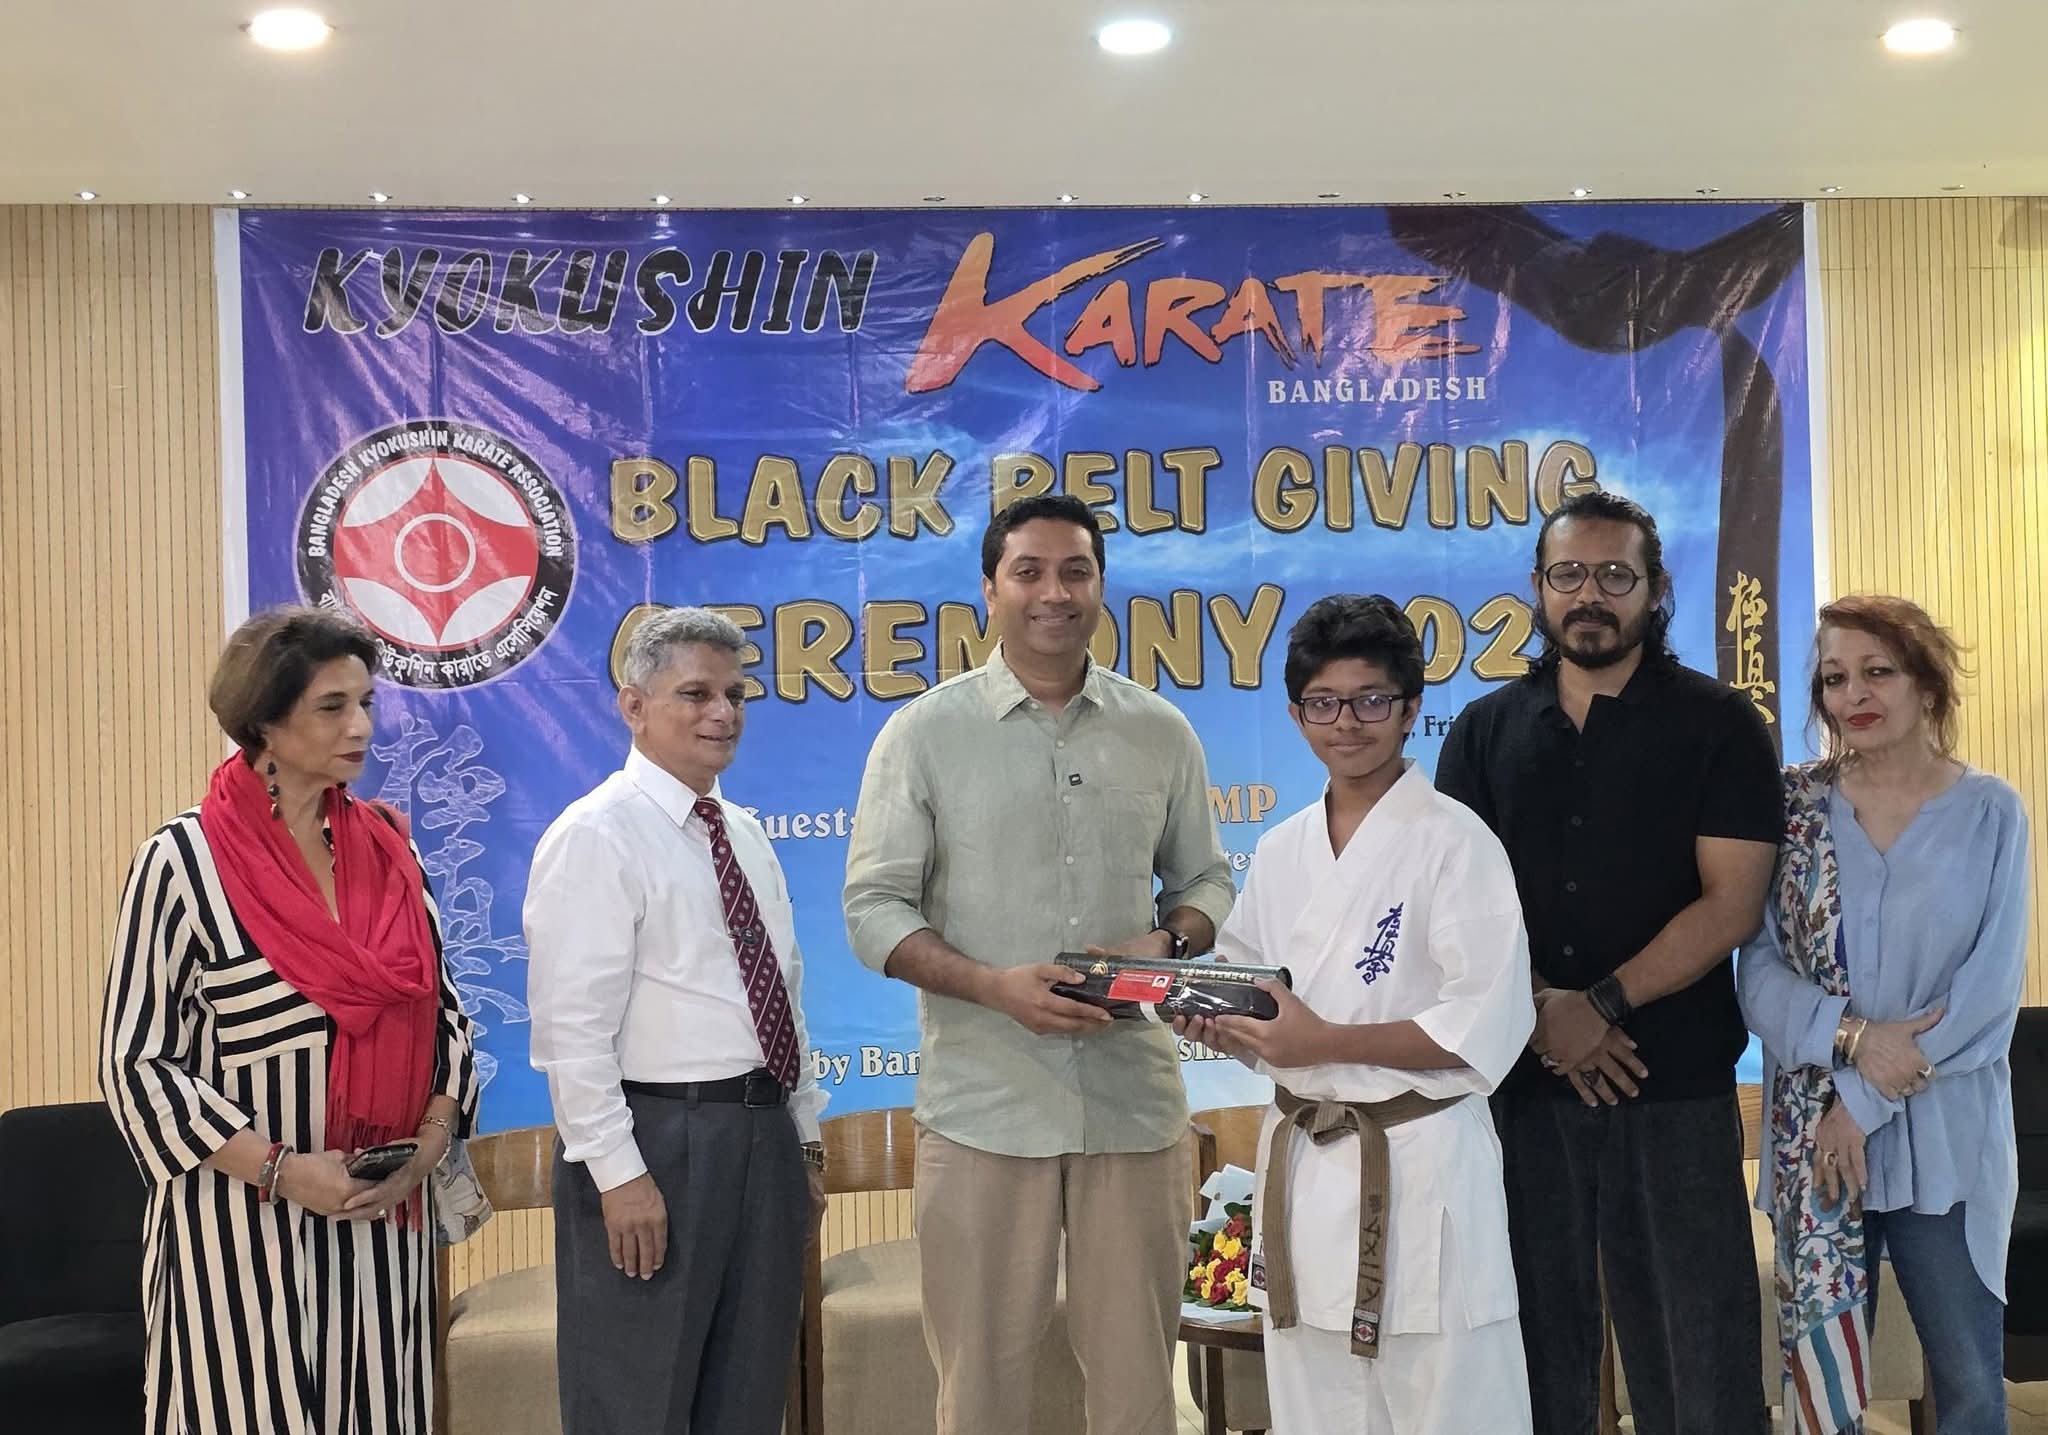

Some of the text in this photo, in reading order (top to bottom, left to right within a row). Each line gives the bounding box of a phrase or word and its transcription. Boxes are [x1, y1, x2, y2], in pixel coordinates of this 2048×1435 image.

[302, 231, 1481, 394] KYOKUSHIN KARATE
[1268, 376, 1487, 404] BANGLADESH
[308, 430, 563, 557] BANGLADESH KYOKUSHIN KARATE ASSOCIATION
[610, 449, 953, 543] BLACK
[1253, 439, 1603, 533] GIVING
[811, 1049, 851, 1085] by
